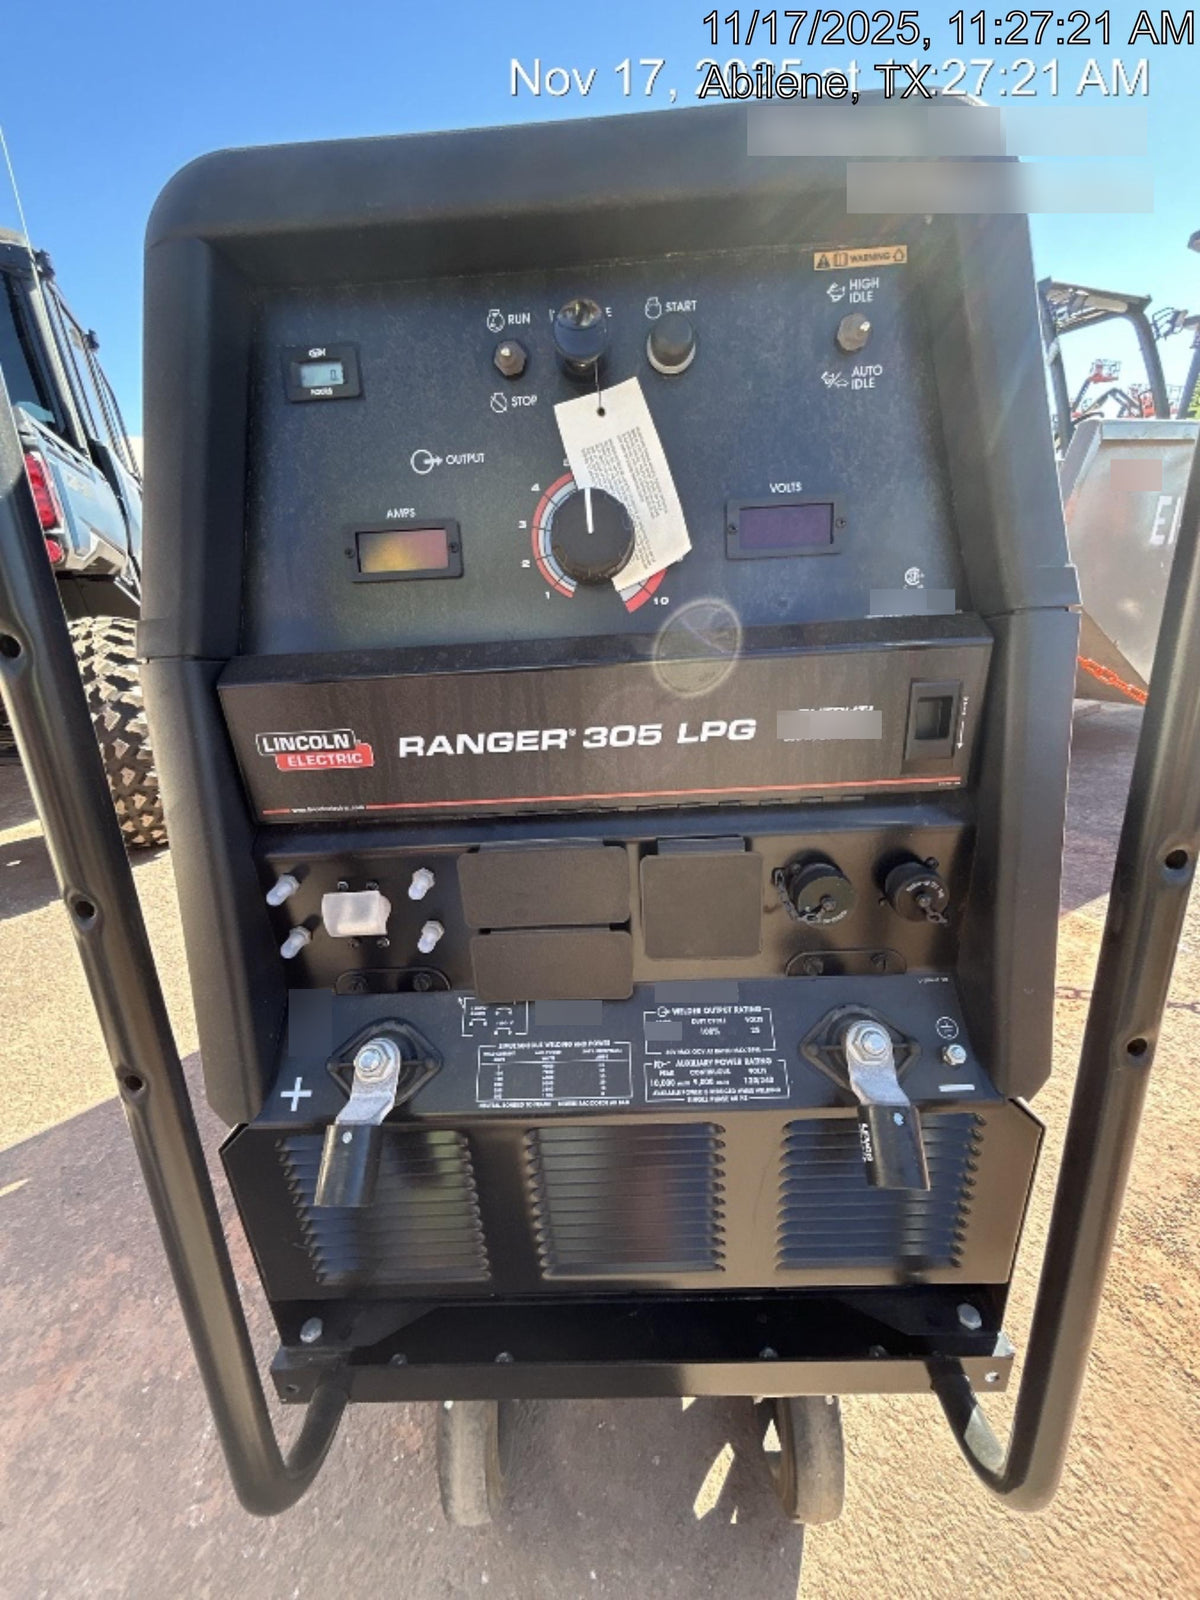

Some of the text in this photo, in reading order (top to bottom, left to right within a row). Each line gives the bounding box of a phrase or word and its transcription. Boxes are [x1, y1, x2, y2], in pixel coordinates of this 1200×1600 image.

[850, 277, 880, 290] HIGH
[850, 291, 874, 303] IDLE
[665, 299, 698, 313] START
[507, 313, 531, 325] RUN
[851, 364, 883, 377] AUTO
[851, 378, 876, 390] IDLE
[511, 394, 538, 407] STOP
[445, 453, 485, 465] OUTPUT
[530, 482, 541, 493] 4
[769, 481, 803, 494] VOLTS
[386, 507, 416, 519] AMPS
[521, 558, 531, 568] 2
[545, 590, 551, 600] 1
[653, 596, 670, 606] 10
[582, 723, 663, 749] 305
[676, 718, 757, 745] LPG
[262, 733, 350, 753] LINCOLN
[286, 752, 364, 768] ELECTRIC
